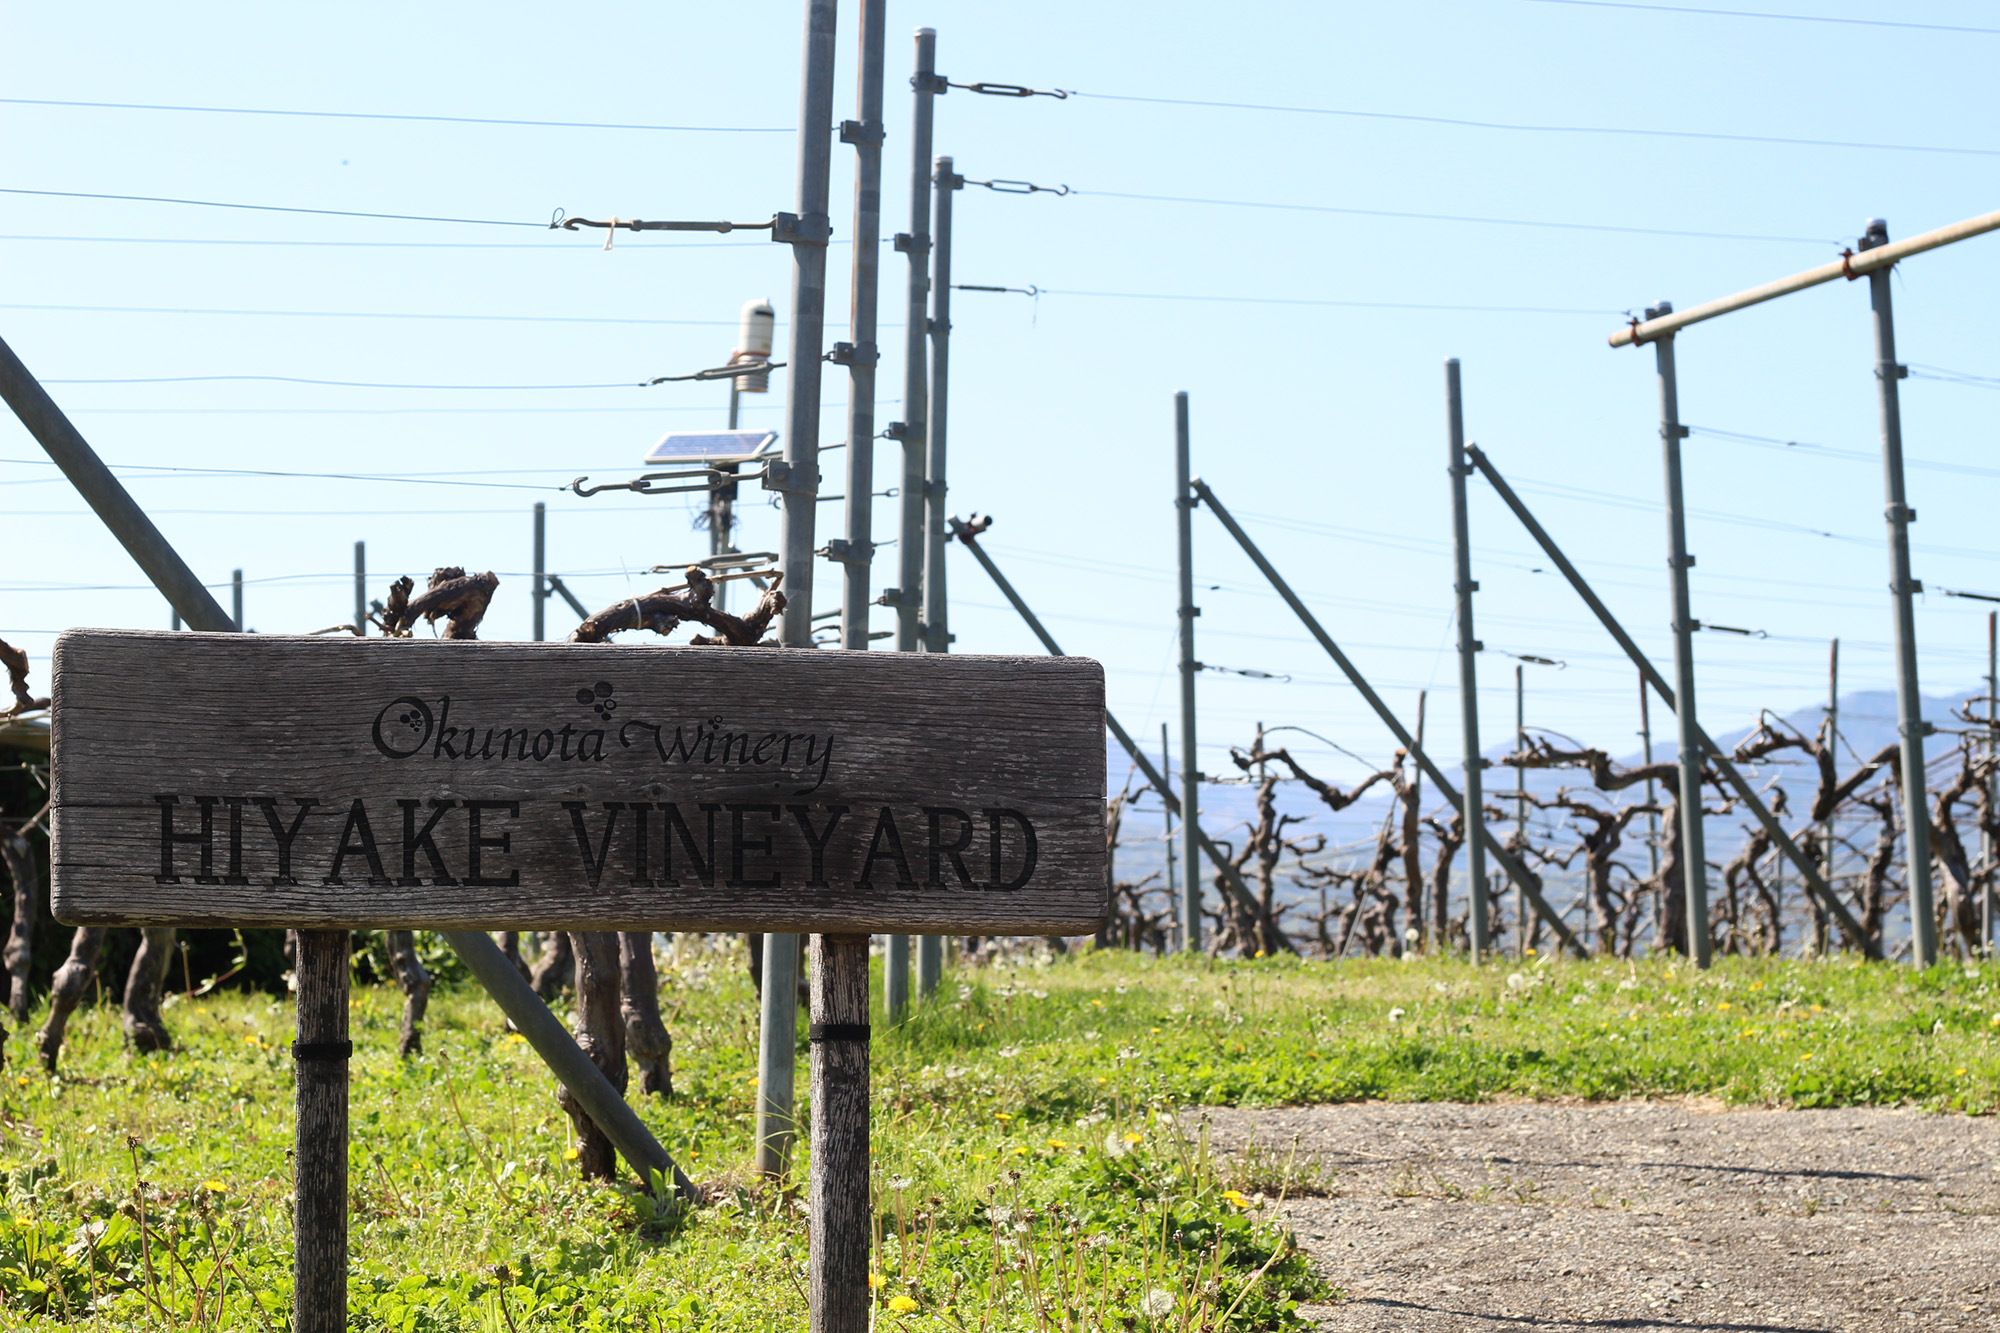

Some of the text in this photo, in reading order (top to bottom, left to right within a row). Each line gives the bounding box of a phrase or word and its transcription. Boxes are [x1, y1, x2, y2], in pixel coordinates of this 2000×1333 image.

[372, 695, 834, 797] Okunota Winery
[154, 796, 1038, 892] HIYAKE VINEYARD
